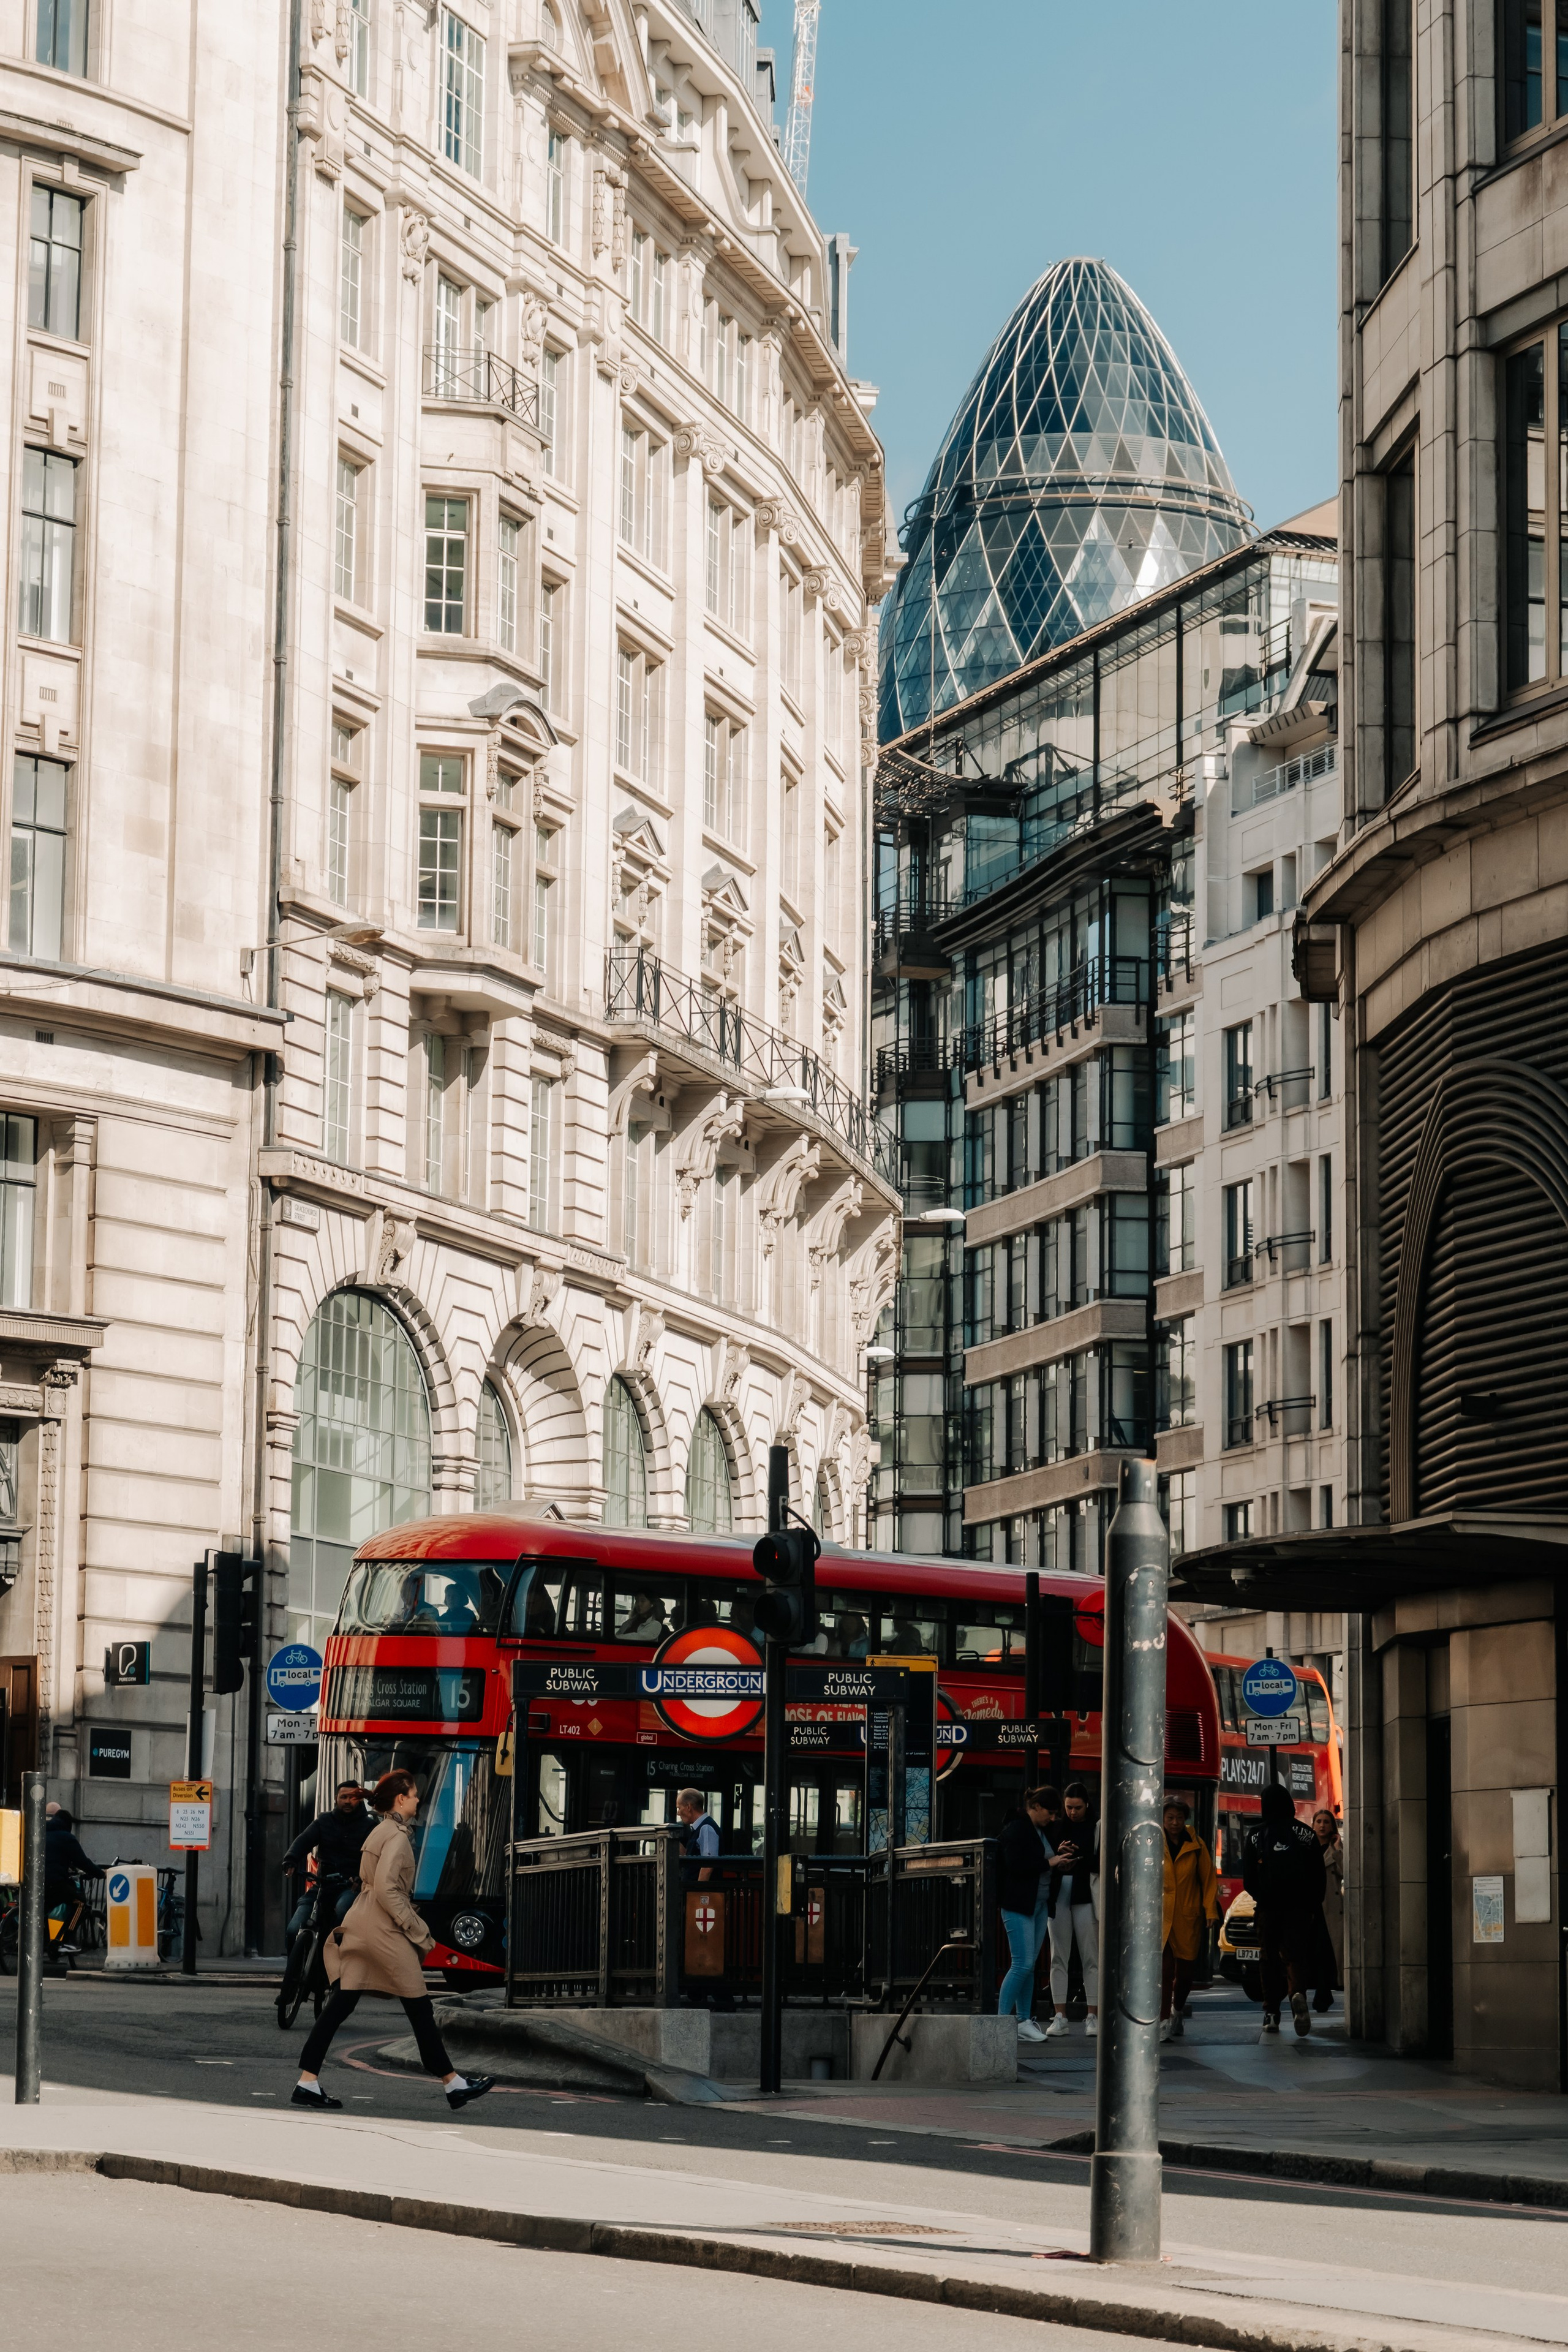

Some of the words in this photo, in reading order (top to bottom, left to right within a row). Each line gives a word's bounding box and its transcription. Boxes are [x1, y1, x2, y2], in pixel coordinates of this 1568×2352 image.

[294, 1204, 317, 1216] GRACECHURCH
[294, 1212, 305, 1221] STREET
[288, 1670, 311, 1678] local
[551, 1668, 595, 1679] PUBLIC
[828, 1673, 872, 1684] PUBLIC
[377, 1679, 397, 1695] Cross
[399, 1679, 428, 1695] Station
[546, 1680, 599, 1691] SUBWAY
[642, 1670, 766, 1694] UNDERGROUN
[1262, 1681, 1283, 1689] local
[451, 1679, 470, 1708] 15
[824, 1685, 876, 1695] SUBWAY
[393, 1699, 421, 1708] SQUARE
[971, 1695, 988, 1708] THERE'S
[277, 1719, 300, 1728] Mon
[559, 1725, 580, 1735] LT402
[794, 1727, 827, 1735] PUBLIC
[1001, 1725, 1035, 1733] PUBLIC
[271, 1730, 277, 1739] 7
[304, 1730, 310, 1739] 7
[312, 1732, 318, 1740] p
[998, 1735, 1038, 1743] SUBWAY
[790, 1736, 830, 1745] SUBWAY
[99, 1747, 129, 1758] PUREGYM
[647, 1761, 656, 1776] 15
[658, 1761, 678, 1773] Charing
[679, 1762, 695, 1771] Cross
[696, 1763, 714, 1772] Station
[1221, 1757, 1246, 1784] PLAYS
[1247, 1760, 1265, 1785] 24/7
